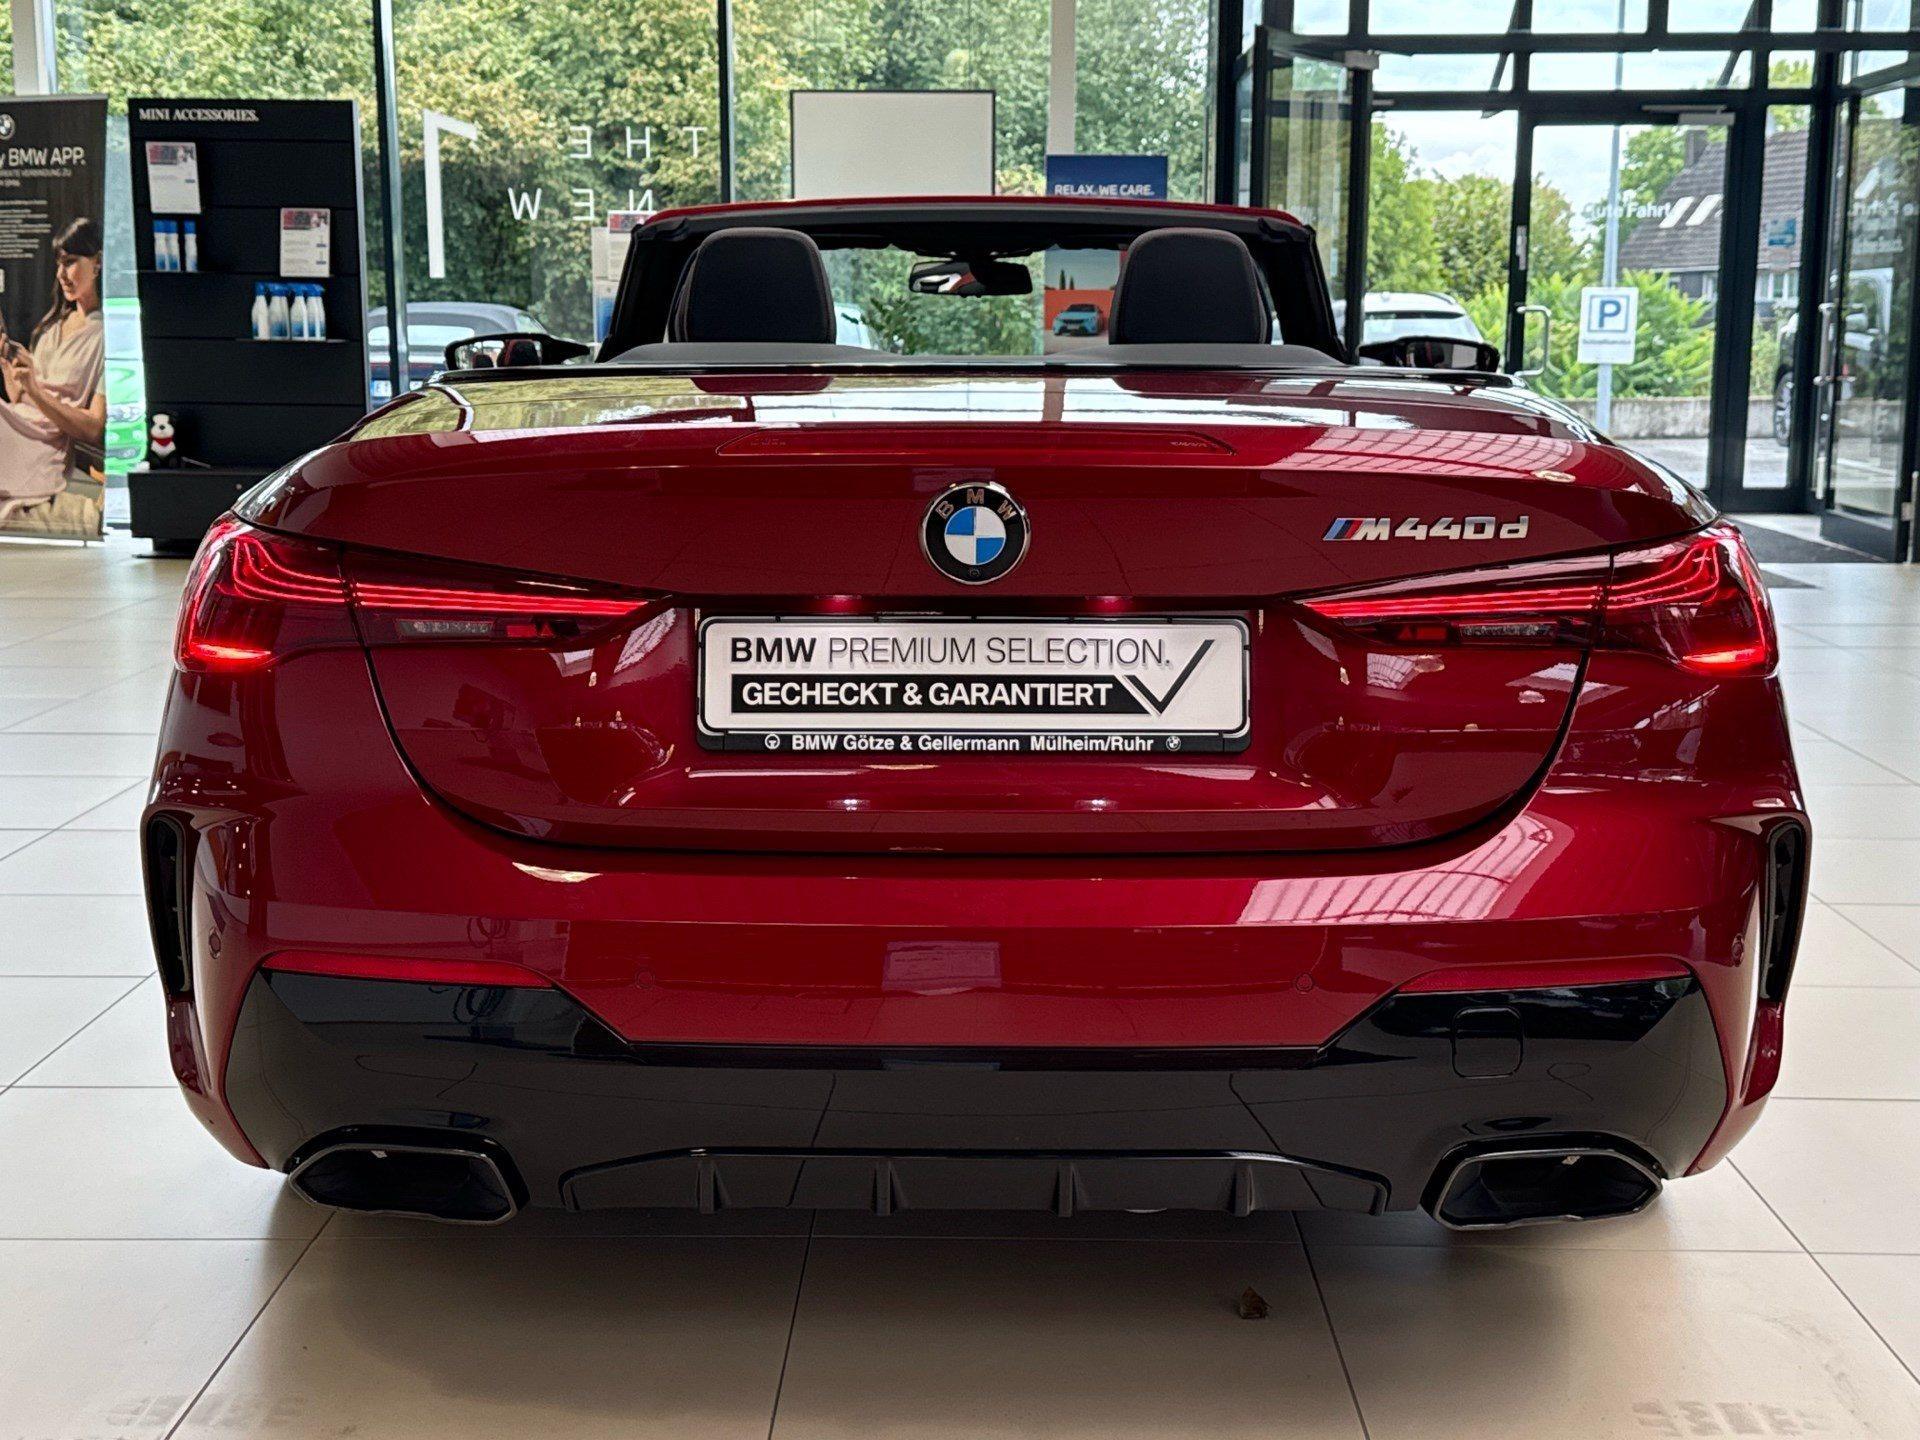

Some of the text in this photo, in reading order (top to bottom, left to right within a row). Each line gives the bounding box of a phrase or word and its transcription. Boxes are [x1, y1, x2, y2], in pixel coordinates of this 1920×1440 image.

[139, 108, 259, 122] MINI ACCESSORIES.
[8, 147, 48, 167] BMW
[50, 146, 86, 166] APP.
[1054, 184, 1155, 196] RELAX. WE CARE.
[1626, 201, 1673, 219] Fahrt
[1598, 300, 1622, 328] P
[935, 488, 1018, 520] BMW
[731, 637, 1171, 665] BMW PREMIUM SELECTION.
[742, 682, 1113, 706] GECHECKT & GARANTIERT
[791, 734, 1154, 751] BMW Götze & Gellermann Mülheim/Ruhr
